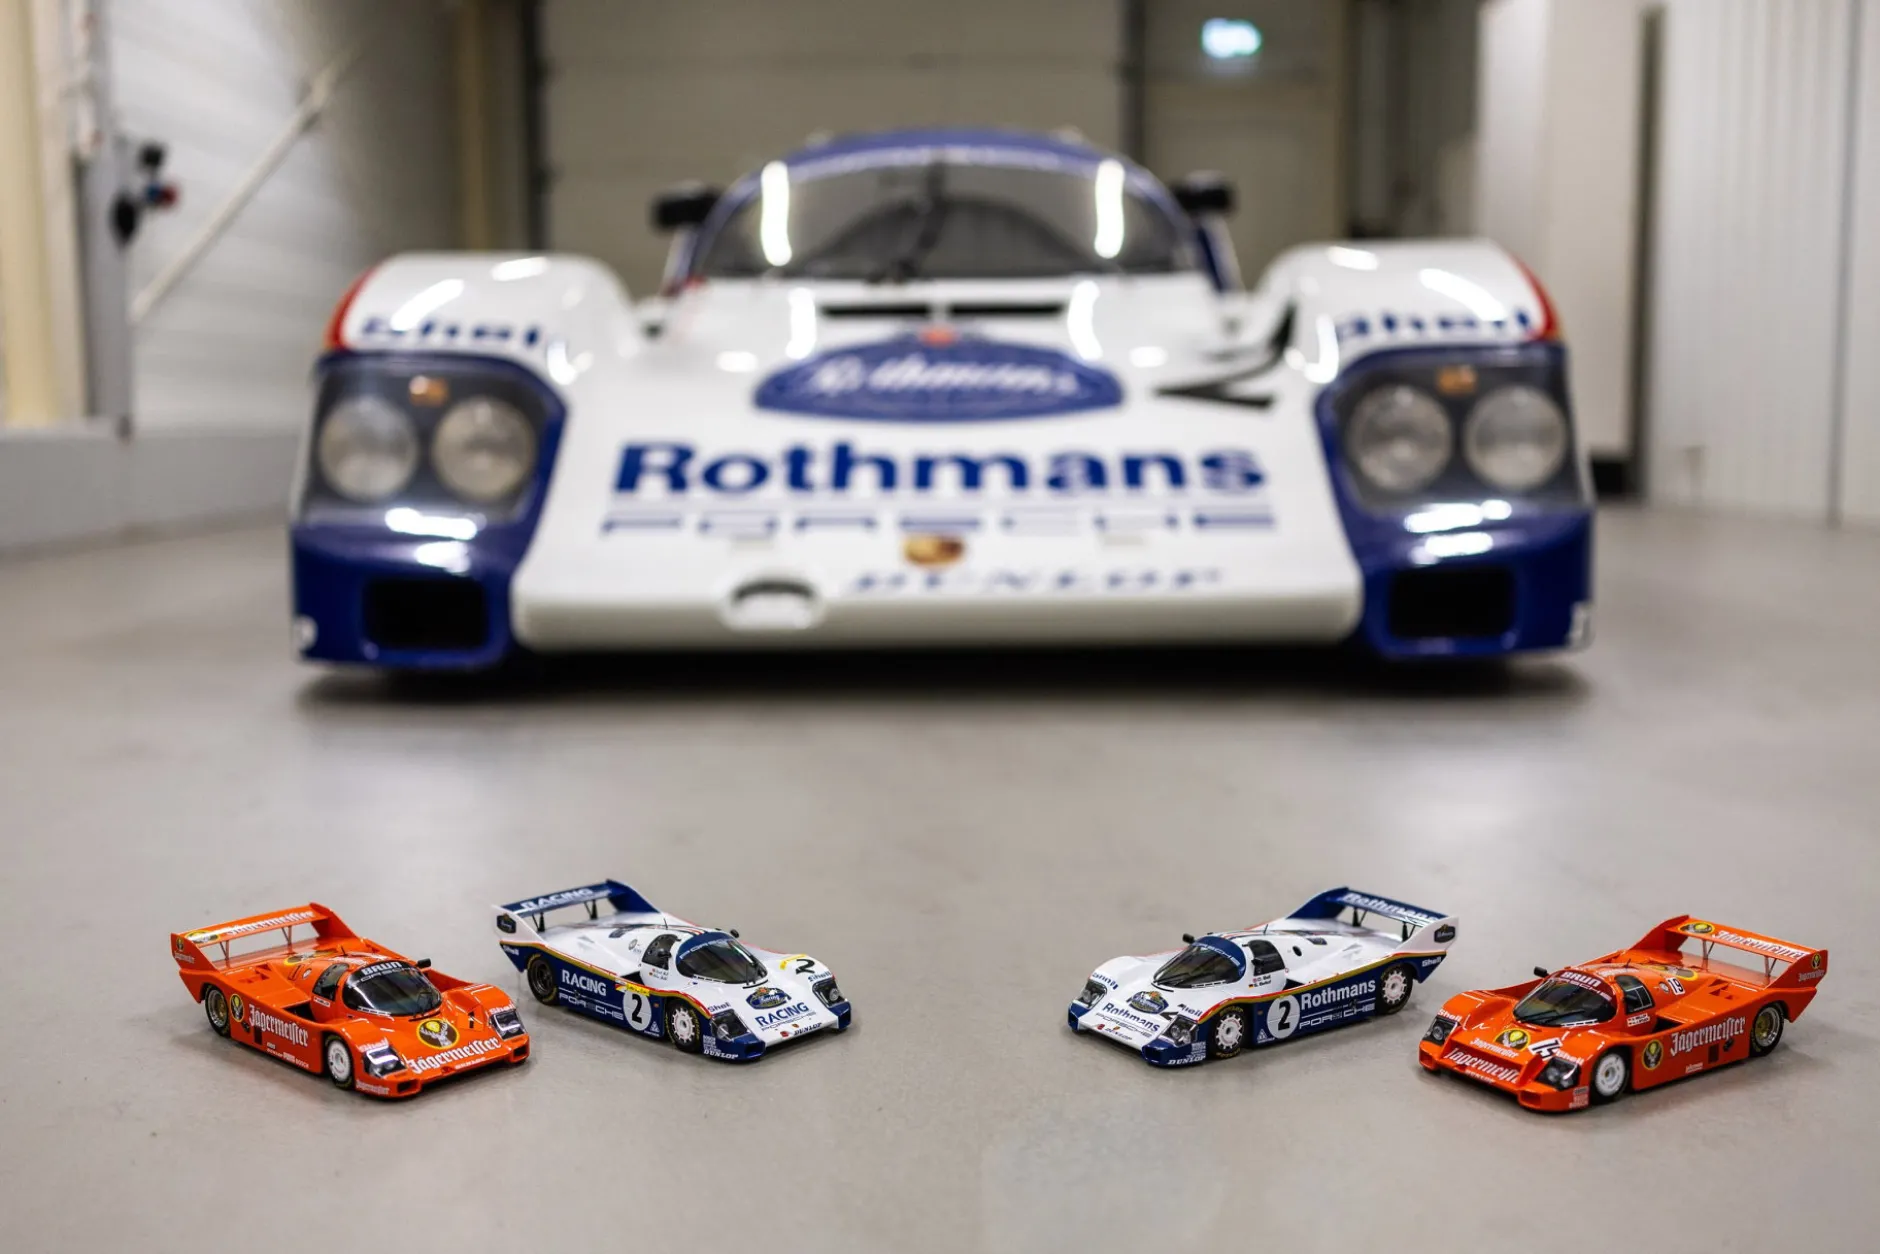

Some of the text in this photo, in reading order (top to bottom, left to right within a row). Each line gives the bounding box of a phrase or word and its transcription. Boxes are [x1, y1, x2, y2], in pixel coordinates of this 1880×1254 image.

[614, 442, 1266, 492] Rothmans
[361, 960, 403, 977] BRUN
[795, 958, 815, 975] 2
[1421, 957, 1442, 968] Shell
[561, 969, 607, 997] RACING
[1561, 971, 1602, 988] BRUN
[559, 992, 624, 1021] PORSCHE
[1301, 979, 1376, 1011] Rothmans
[631, 993, 643, 1024] 2
[755, 1002, 809, 1027] RACING
[1102, 1002, 1161, 1033] Rothmans
[1277, 1000, 1291, 1031] 2
[1300, 1002, 1375, 1030] PORSCHE
[1438, 1009, 1462, 1022] Shell
[794, 1022, 822, 1036] DUNLOP
[1670, 1016, 1746, 1057] Jägermeister
[408, 1037, 502, 1075] Jägermeister
[704, 1049, 738, 1060] DUNLOP
[1167, 1055, 1206, 1066] DUNLOP
[1554, 1049, 1584, 1066] Shell
